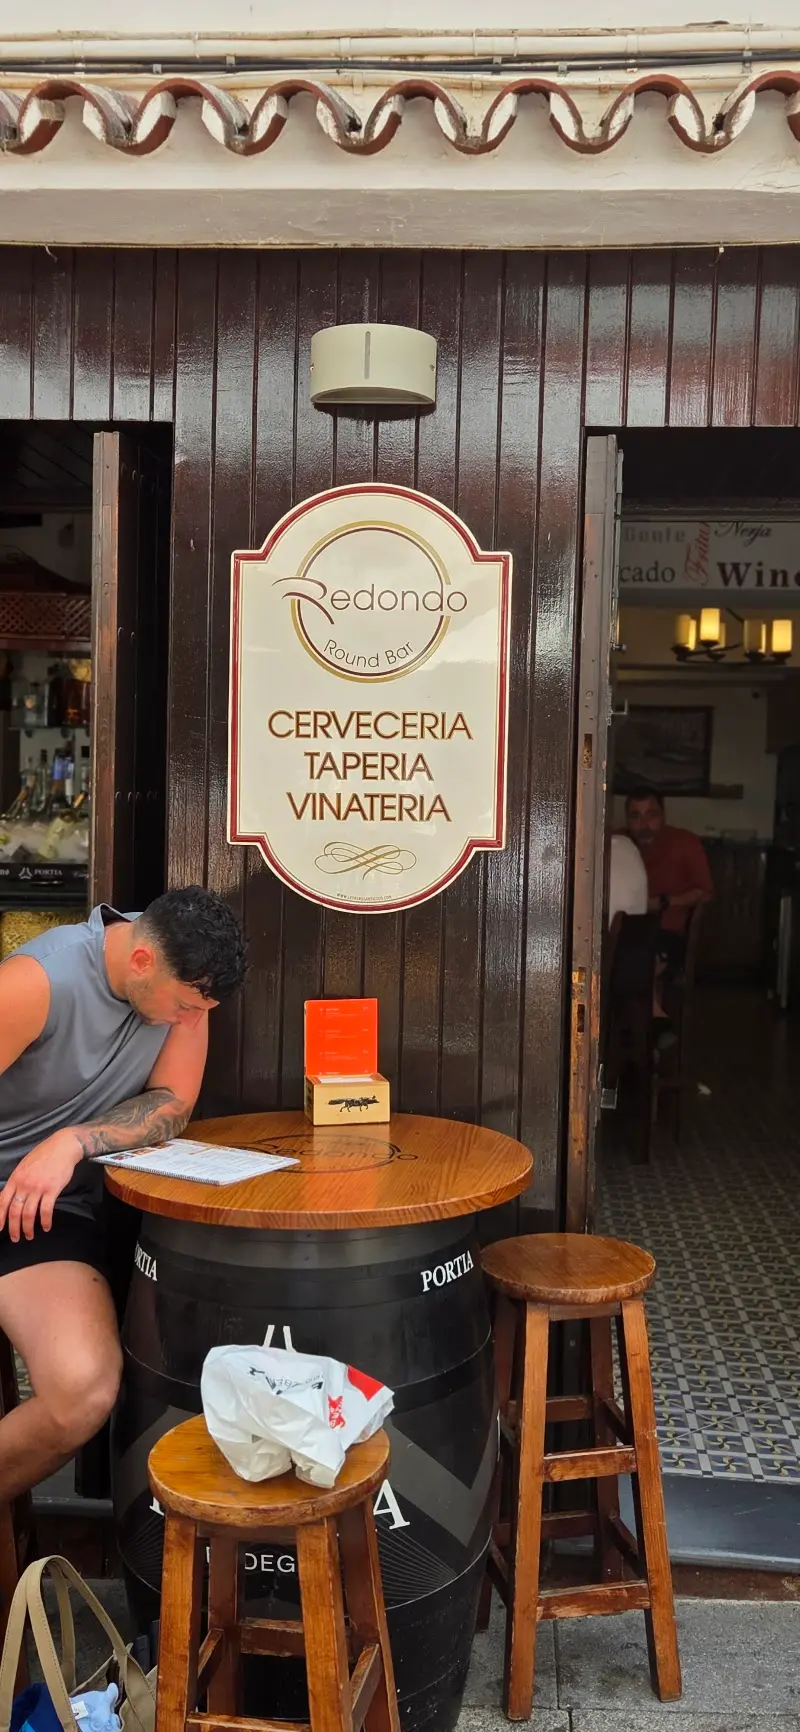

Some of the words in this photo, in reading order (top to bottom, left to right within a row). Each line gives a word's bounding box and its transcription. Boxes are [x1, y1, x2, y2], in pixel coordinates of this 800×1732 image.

[714, 521, 772, 547] Nerja
[271, 576, 468, 625] Redondo
[323, 638, 380, 669] Round
[386, 641, 416, 665] Bar
[267, 709, 474, 740] CERVECERIA
[304, 751, 435, 782] TAPERIA
[286, 792, 453, 823] VINATERIA
[420, 1250, 474, 1292] PORTIA
